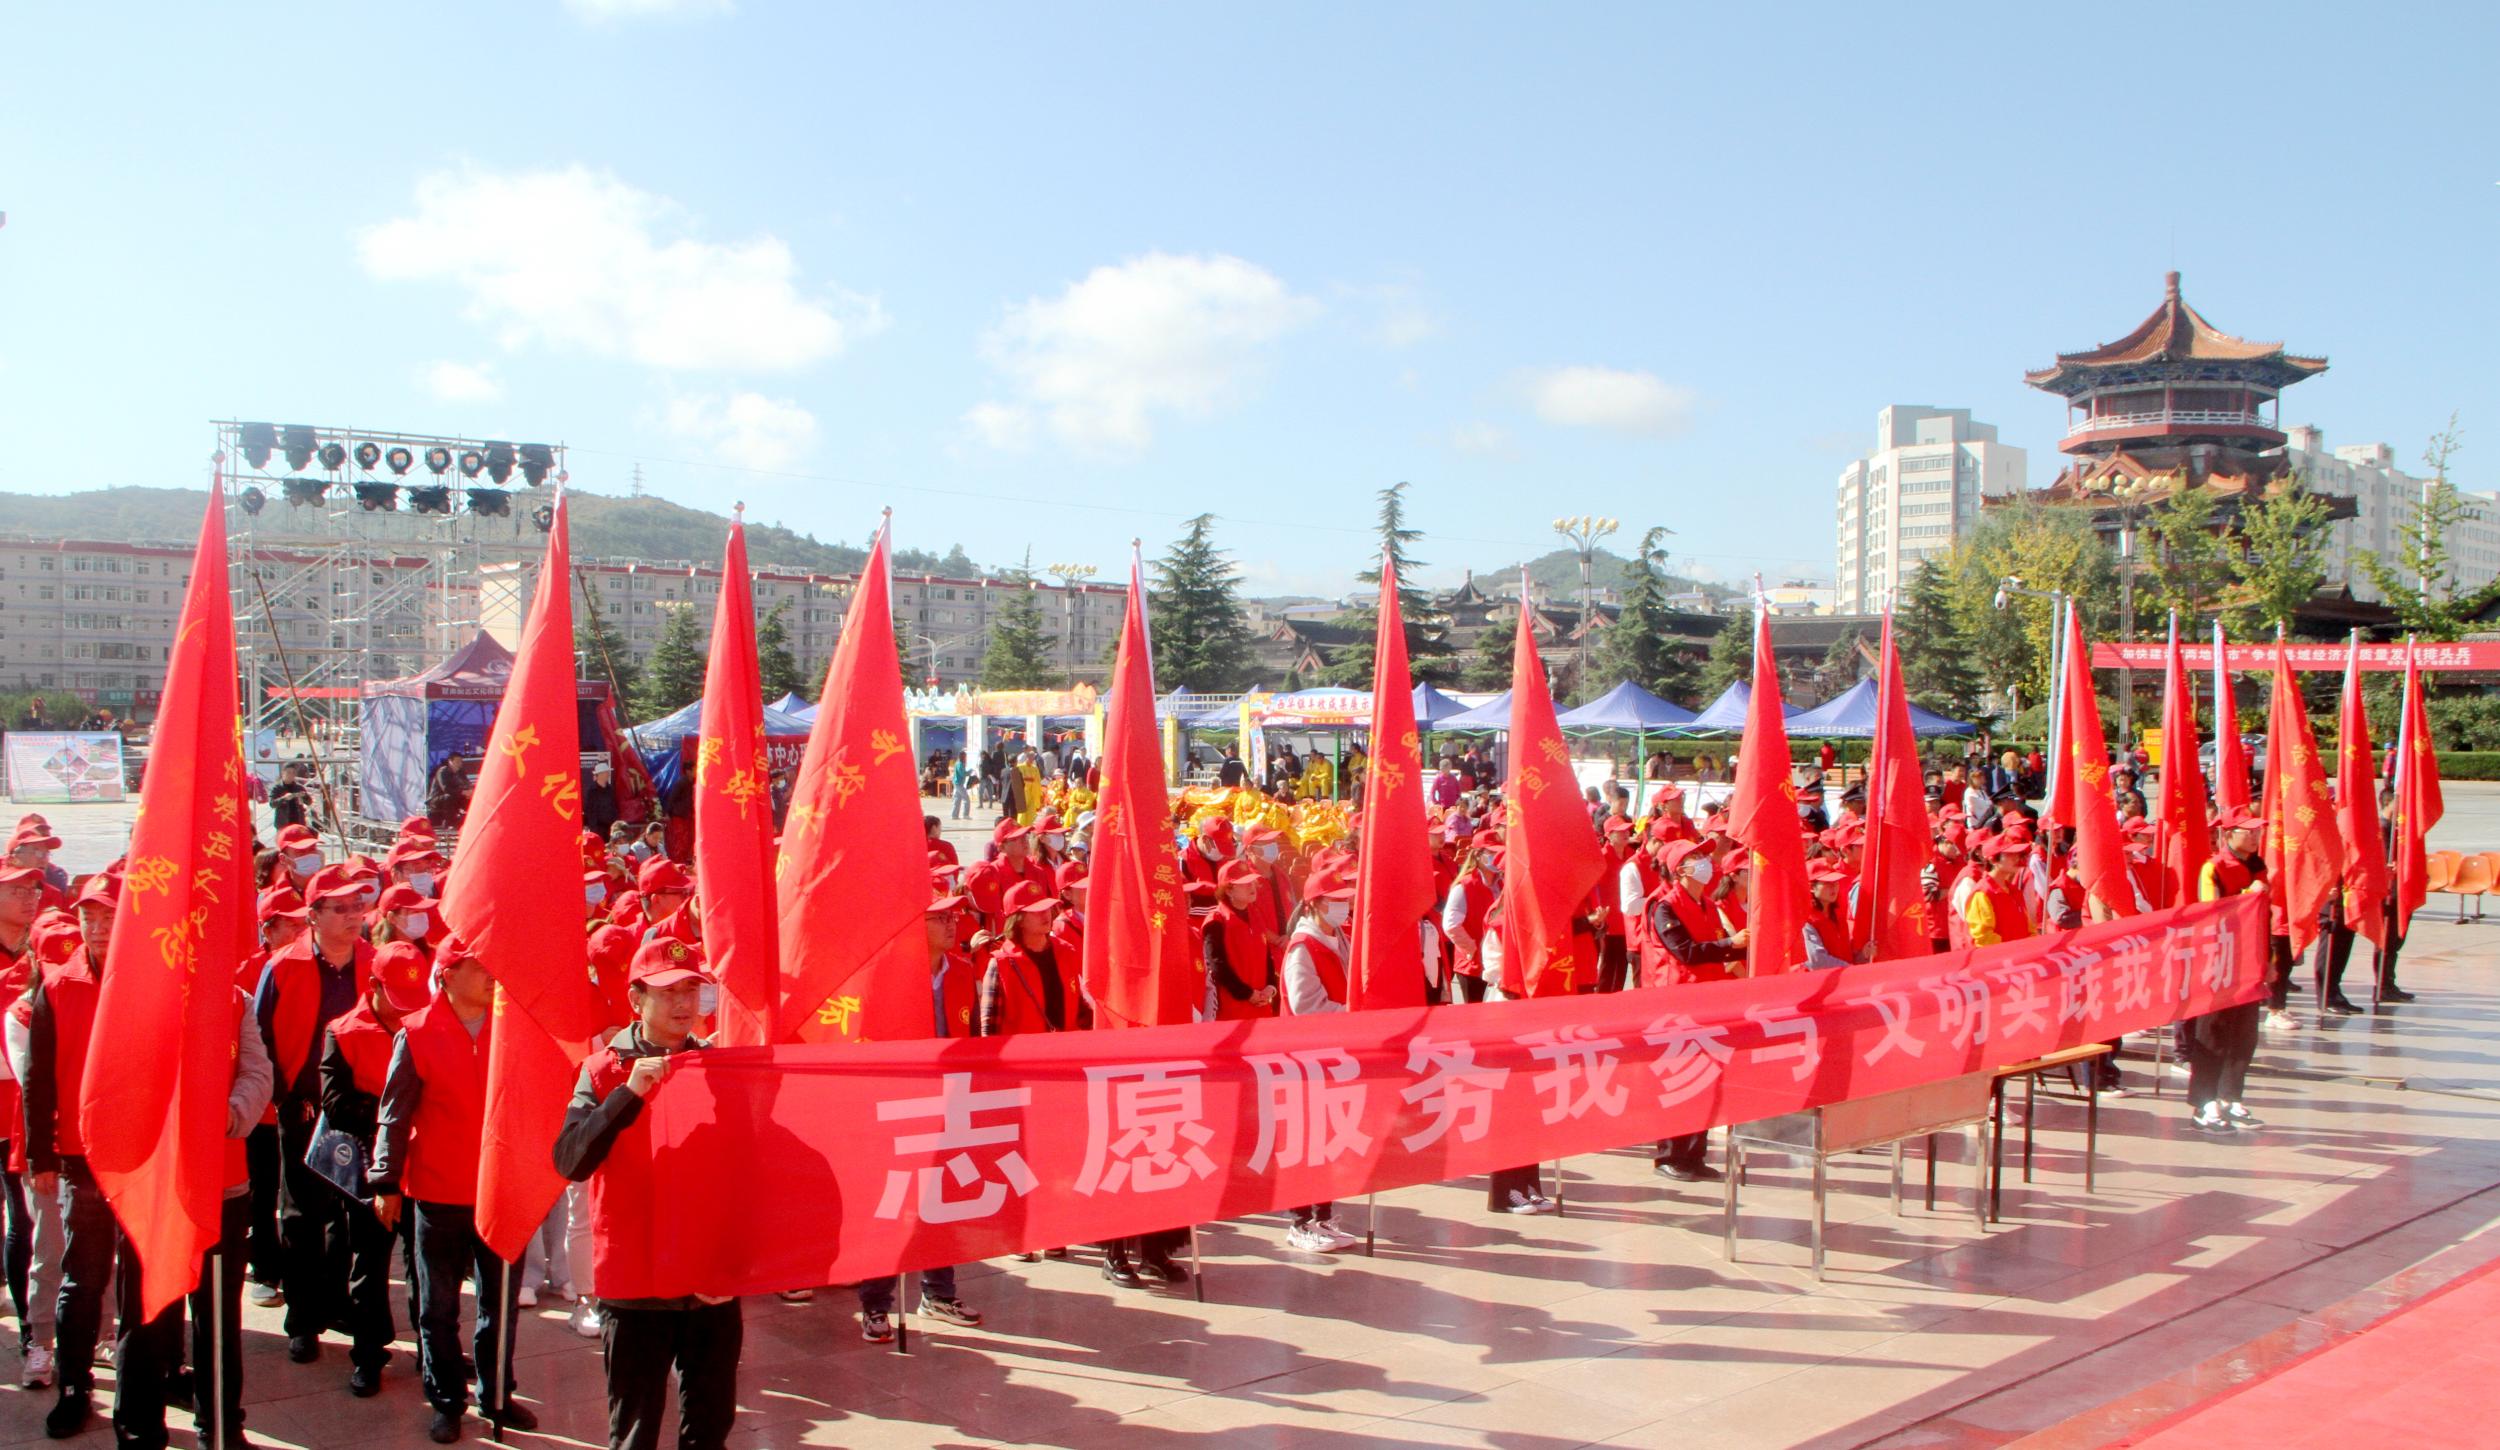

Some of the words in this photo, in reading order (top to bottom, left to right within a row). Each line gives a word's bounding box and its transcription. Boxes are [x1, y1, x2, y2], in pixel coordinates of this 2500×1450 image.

[874, 1003, 1821, 1224] 志愿服务我参与
[1846, 918, 2235, 1067] 文明实践我行动
